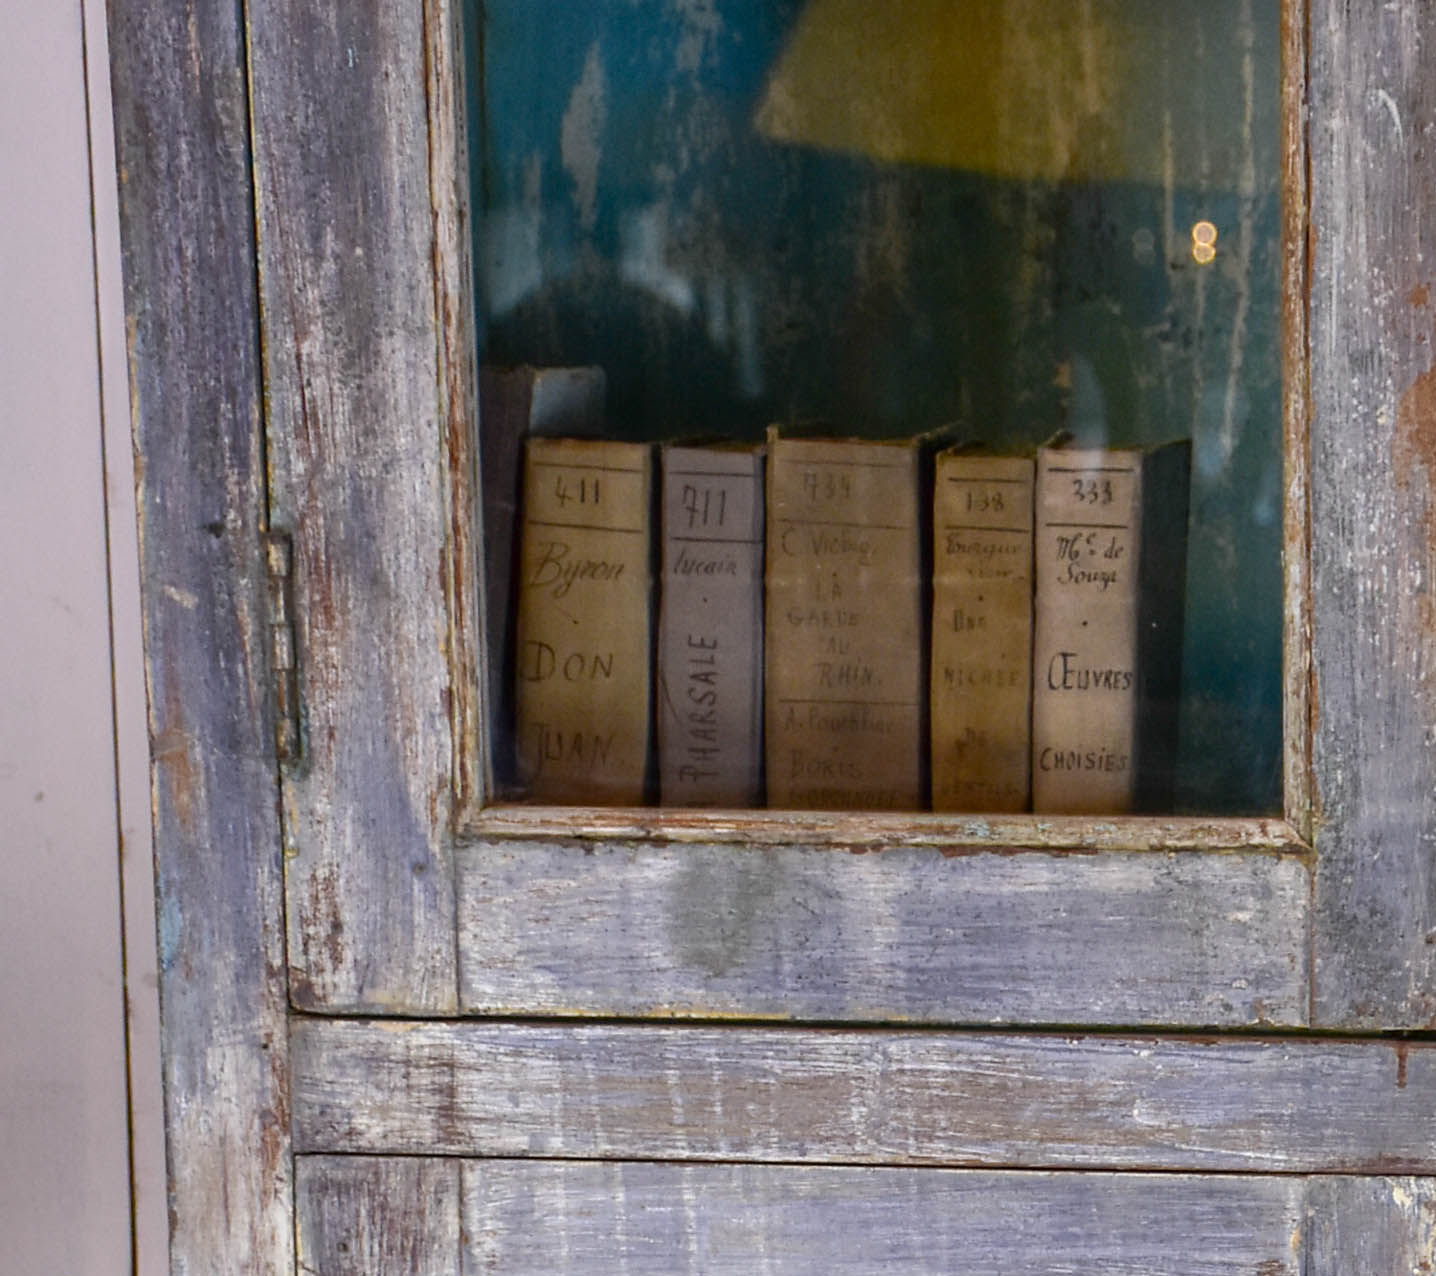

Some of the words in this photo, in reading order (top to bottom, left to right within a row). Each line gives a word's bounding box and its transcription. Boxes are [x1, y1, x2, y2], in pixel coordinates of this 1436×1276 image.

[554, 476, 600, 508] 411
[682, 483, 728, 529] 711
[530, 539, 625, 598] Byron
[522, 638, 614, 681] DON
[679, 633, 721, 784] PHARSALE
[1039, 746, 1128, 773] CHOISIES
